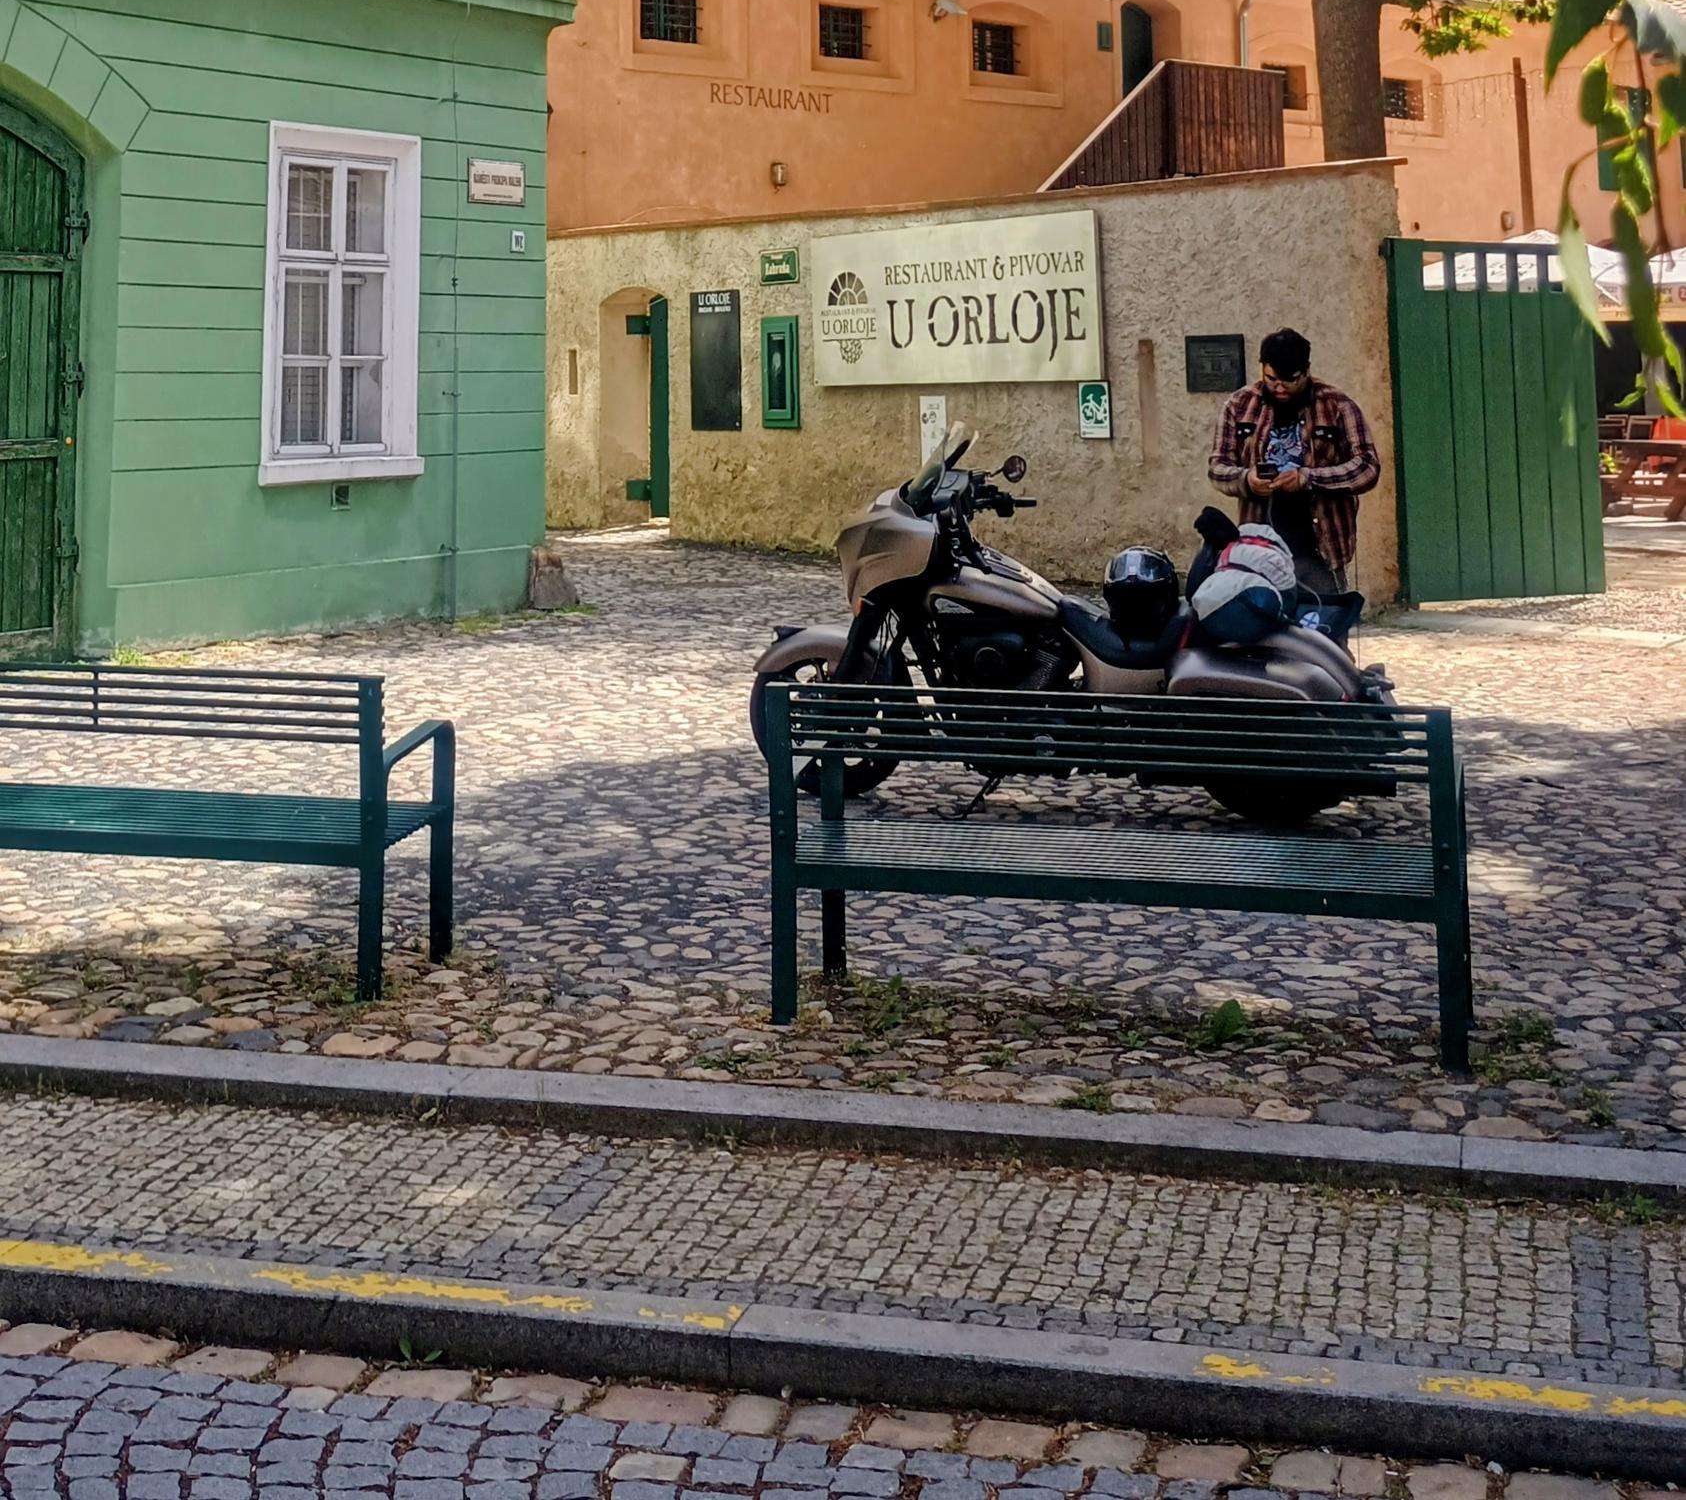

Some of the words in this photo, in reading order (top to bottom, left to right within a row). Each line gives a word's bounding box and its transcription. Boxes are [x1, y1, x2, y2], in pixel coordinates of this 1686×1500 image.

[710, 82, 833, 113] RESTAURANT
[884, 258, 987, 286] RESTAURANT
[993, 255, 1005, 281] &
[1009, 250, 1085, 277] PIVOVAR
[698, 294, 704, 306] U
[705, 292, 731, 306] ORLOJE
[821, 319, 830, 336] U
[833, 317, 877, 337] ORLOJE
[886, 299, 915, 349] U
[928, 287, 1086, 362] ORLOJE
